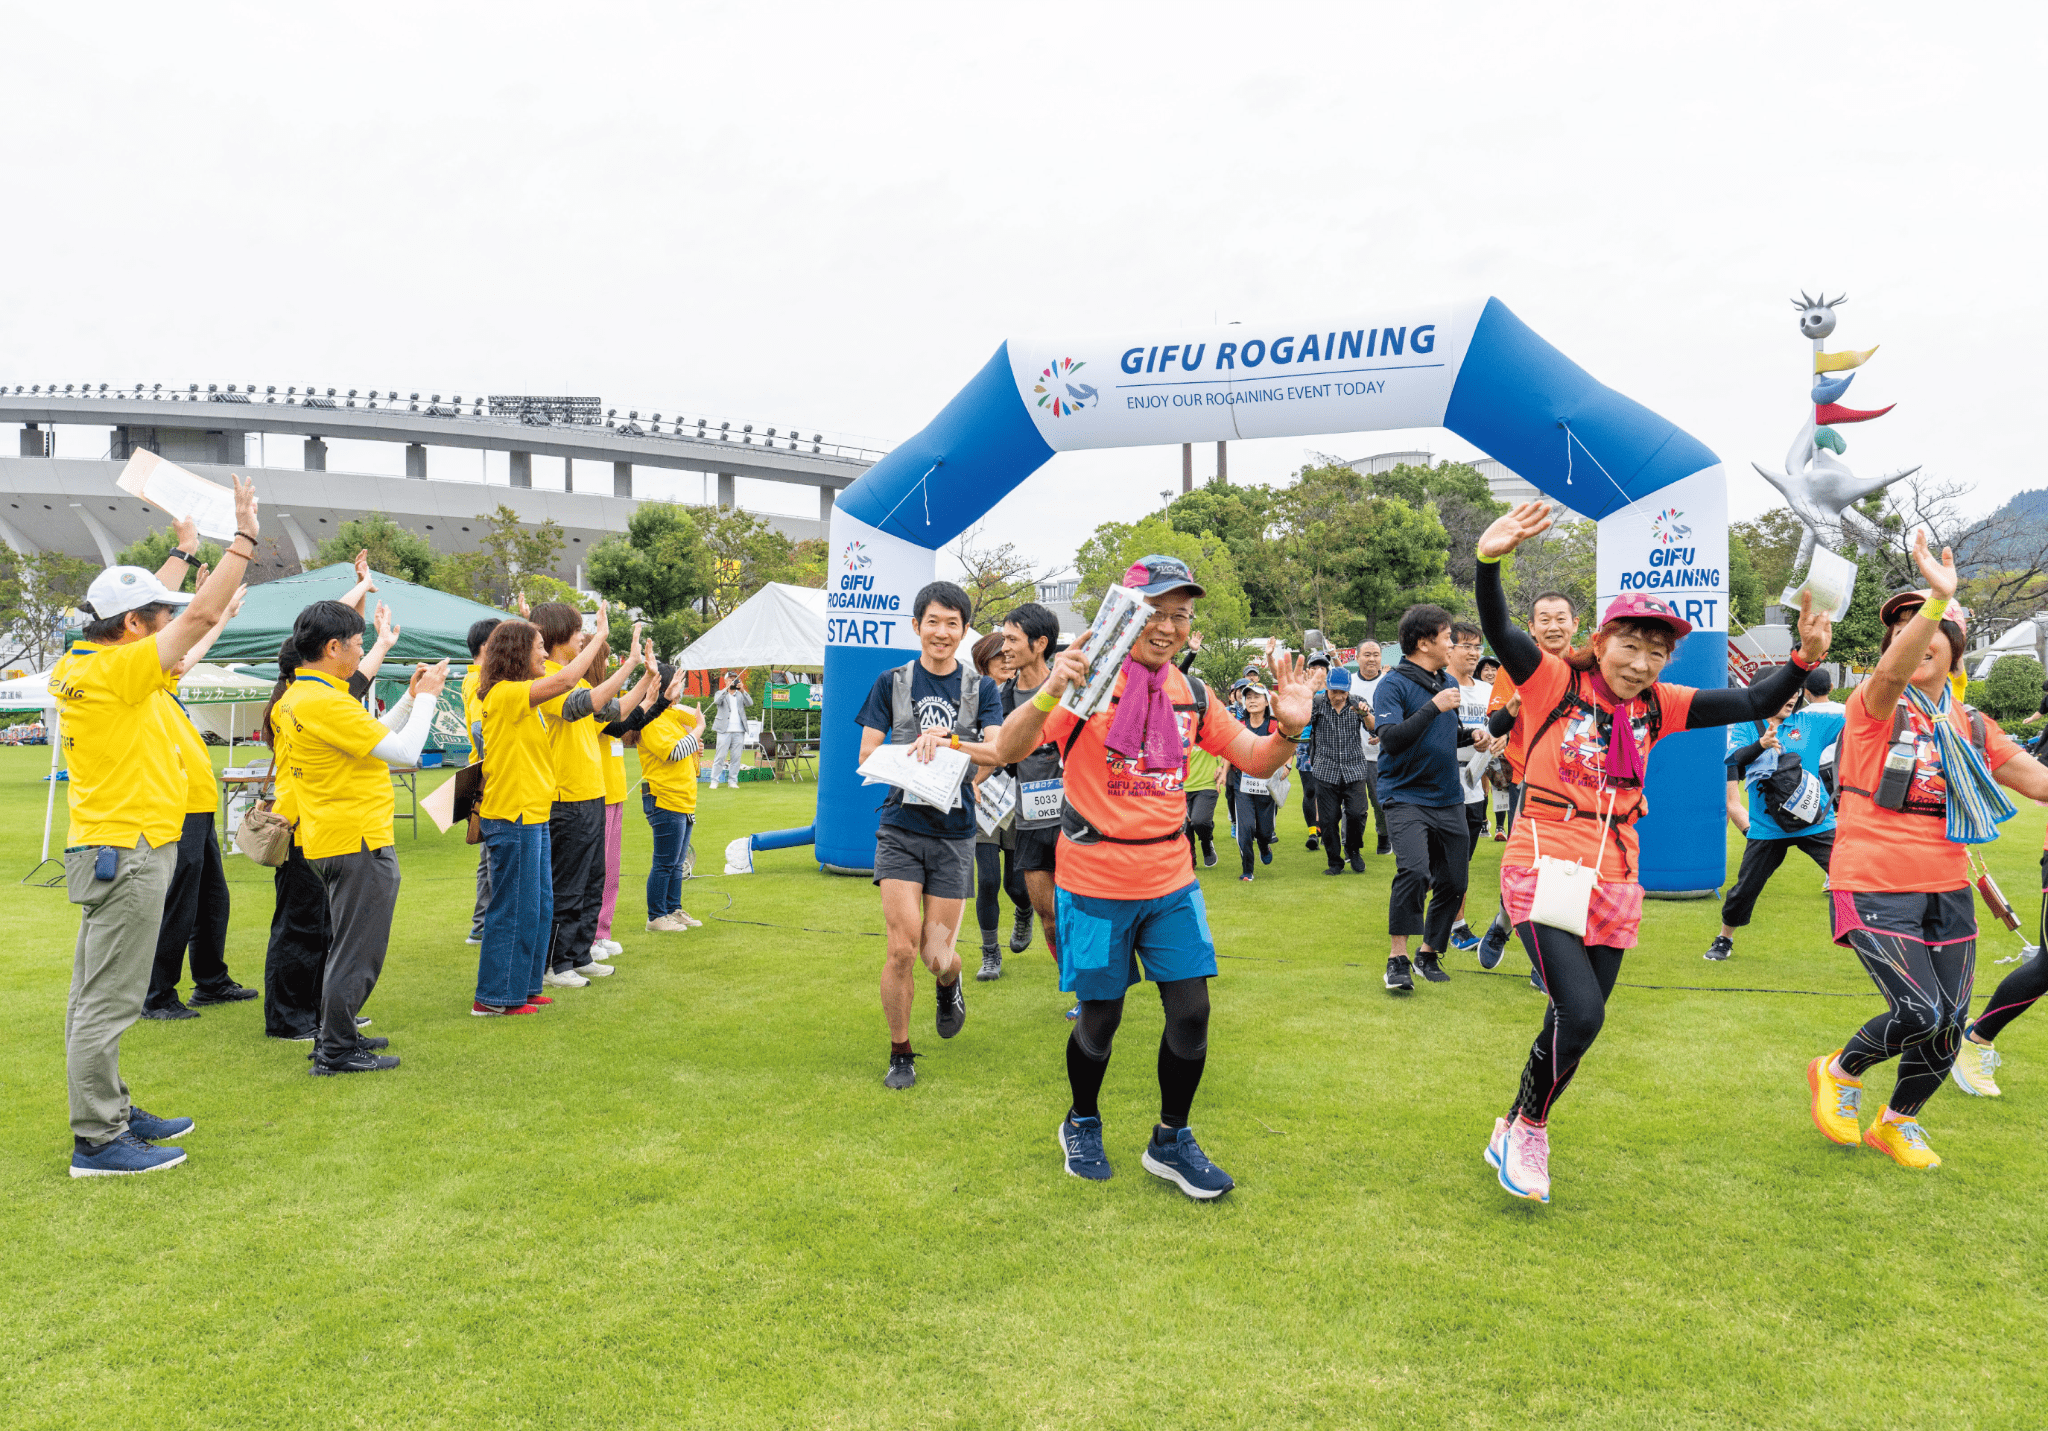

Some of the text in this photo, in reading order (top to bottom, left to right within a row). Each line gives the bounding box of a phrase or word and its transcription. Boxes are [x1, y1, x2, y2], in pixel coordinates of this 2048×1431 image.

[1121, 324, 1436, 374] GIFU ROGAINING
[1127, 380, 1385, 409] ENJOY OUR ROGAINING EVENT TODAY
[1649, 547, 1695, 567] GIFU
[840, 574, 875, 591] GIFU
[1620, 569, 1720, 590] ROGAINING
[828, 592, 900, 611] ROGAINING
[1669, 599, 1718, 628] ART
[828, 618, 896, 645] START
[1559, 767, 1580, 779] GIFU
[1107, 781, 1156, 790] GIFU 2024
[1108, 789, 1126, 797] HALF
[1034, 793, 1057, 806] 5033
